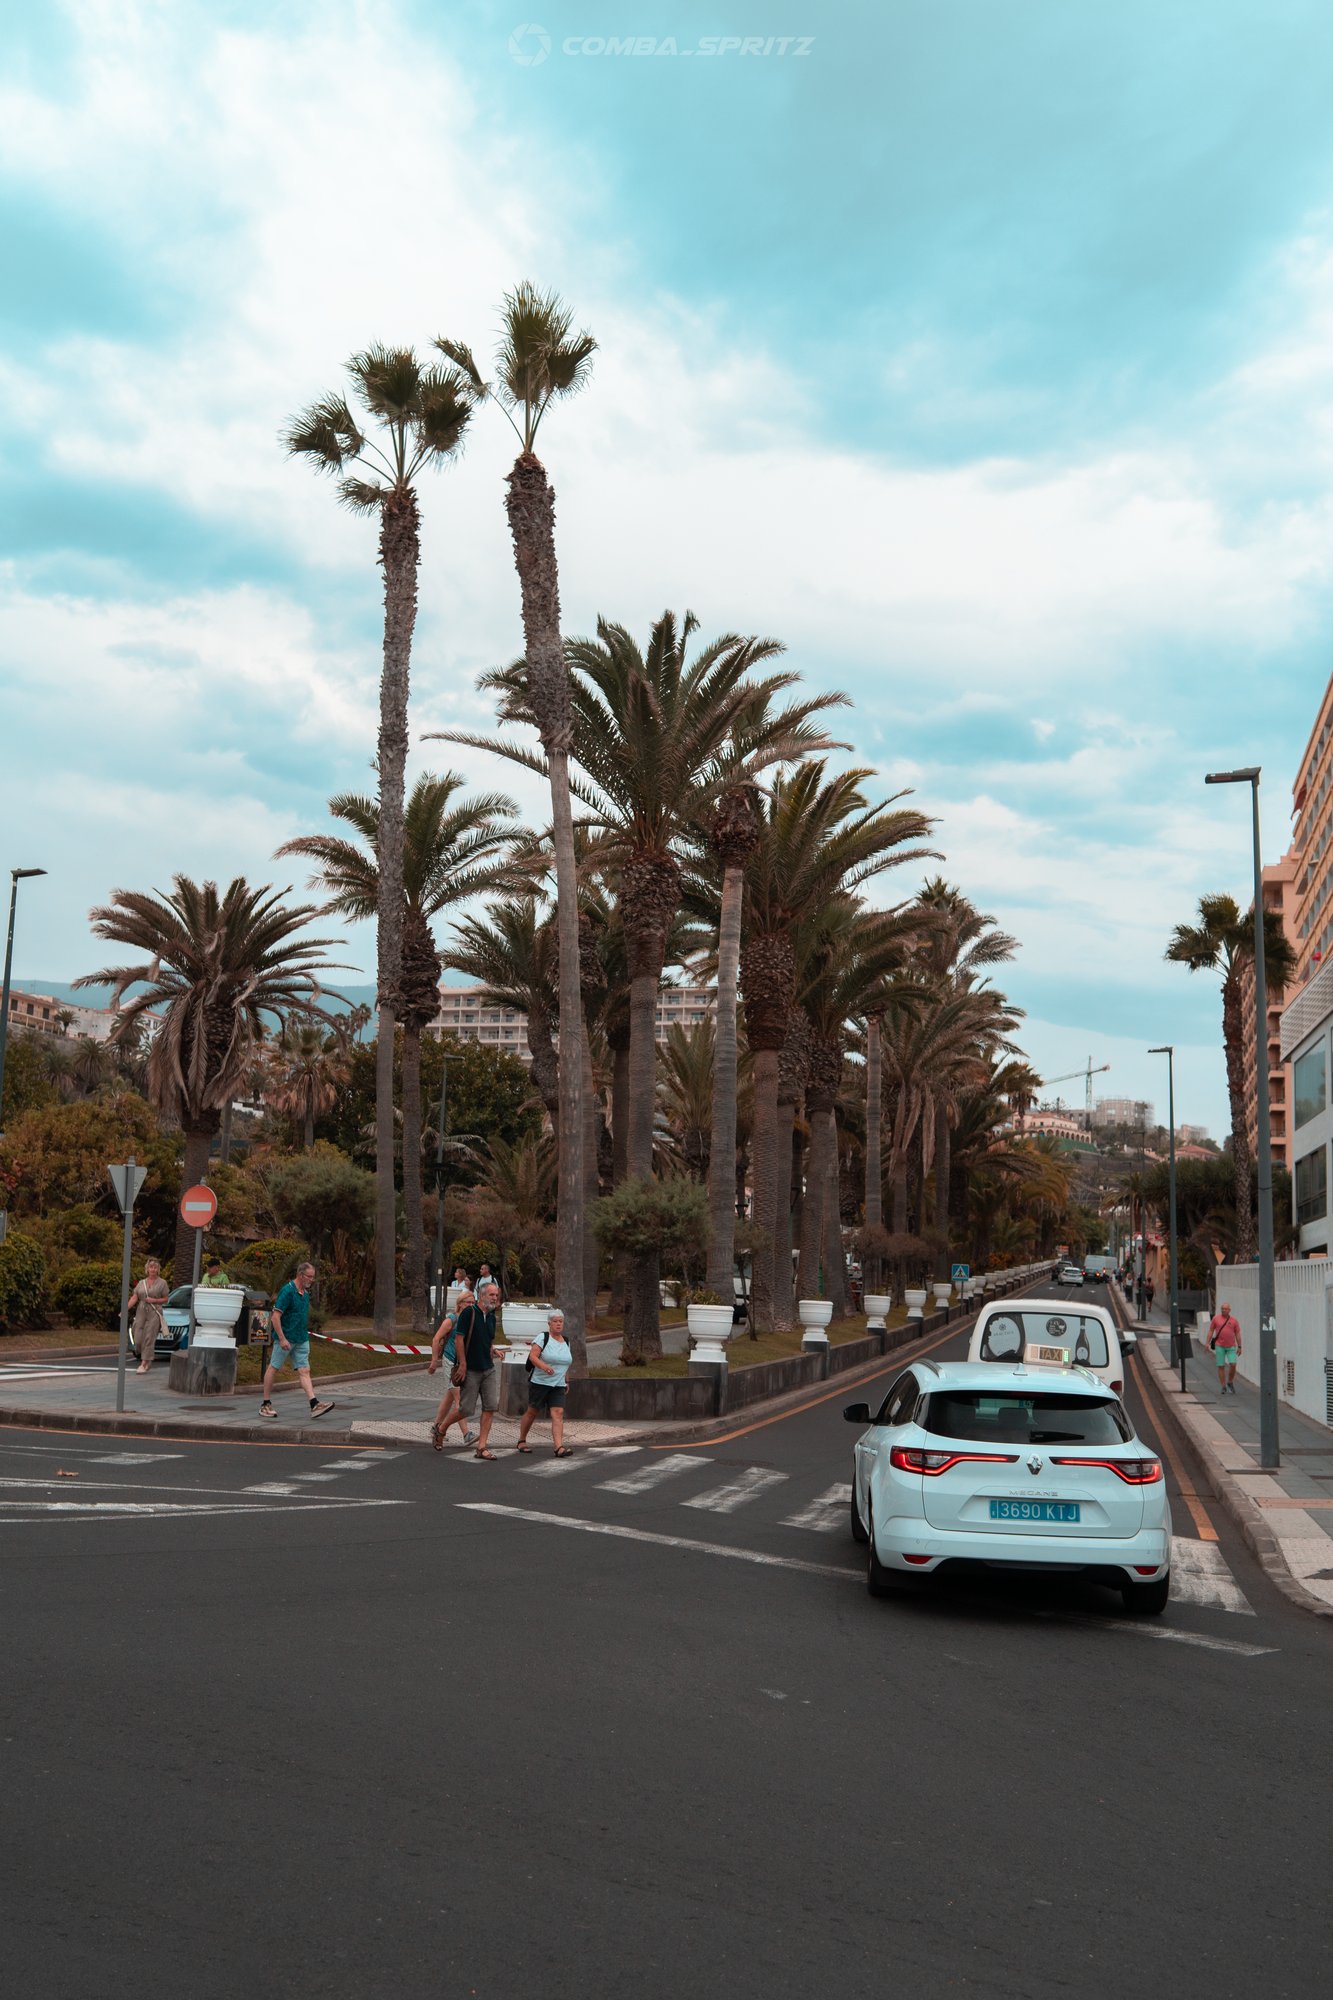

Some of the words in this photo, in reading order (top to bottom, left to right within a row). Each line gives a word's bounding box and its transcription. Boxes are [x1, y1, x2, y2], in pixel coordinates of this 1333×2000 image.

[1040, 1348, 1062, 1361] TAXI
[1001, 1503, 1040, 1518] 3690
[1046, 1504, 1076, 1520] KTJ
